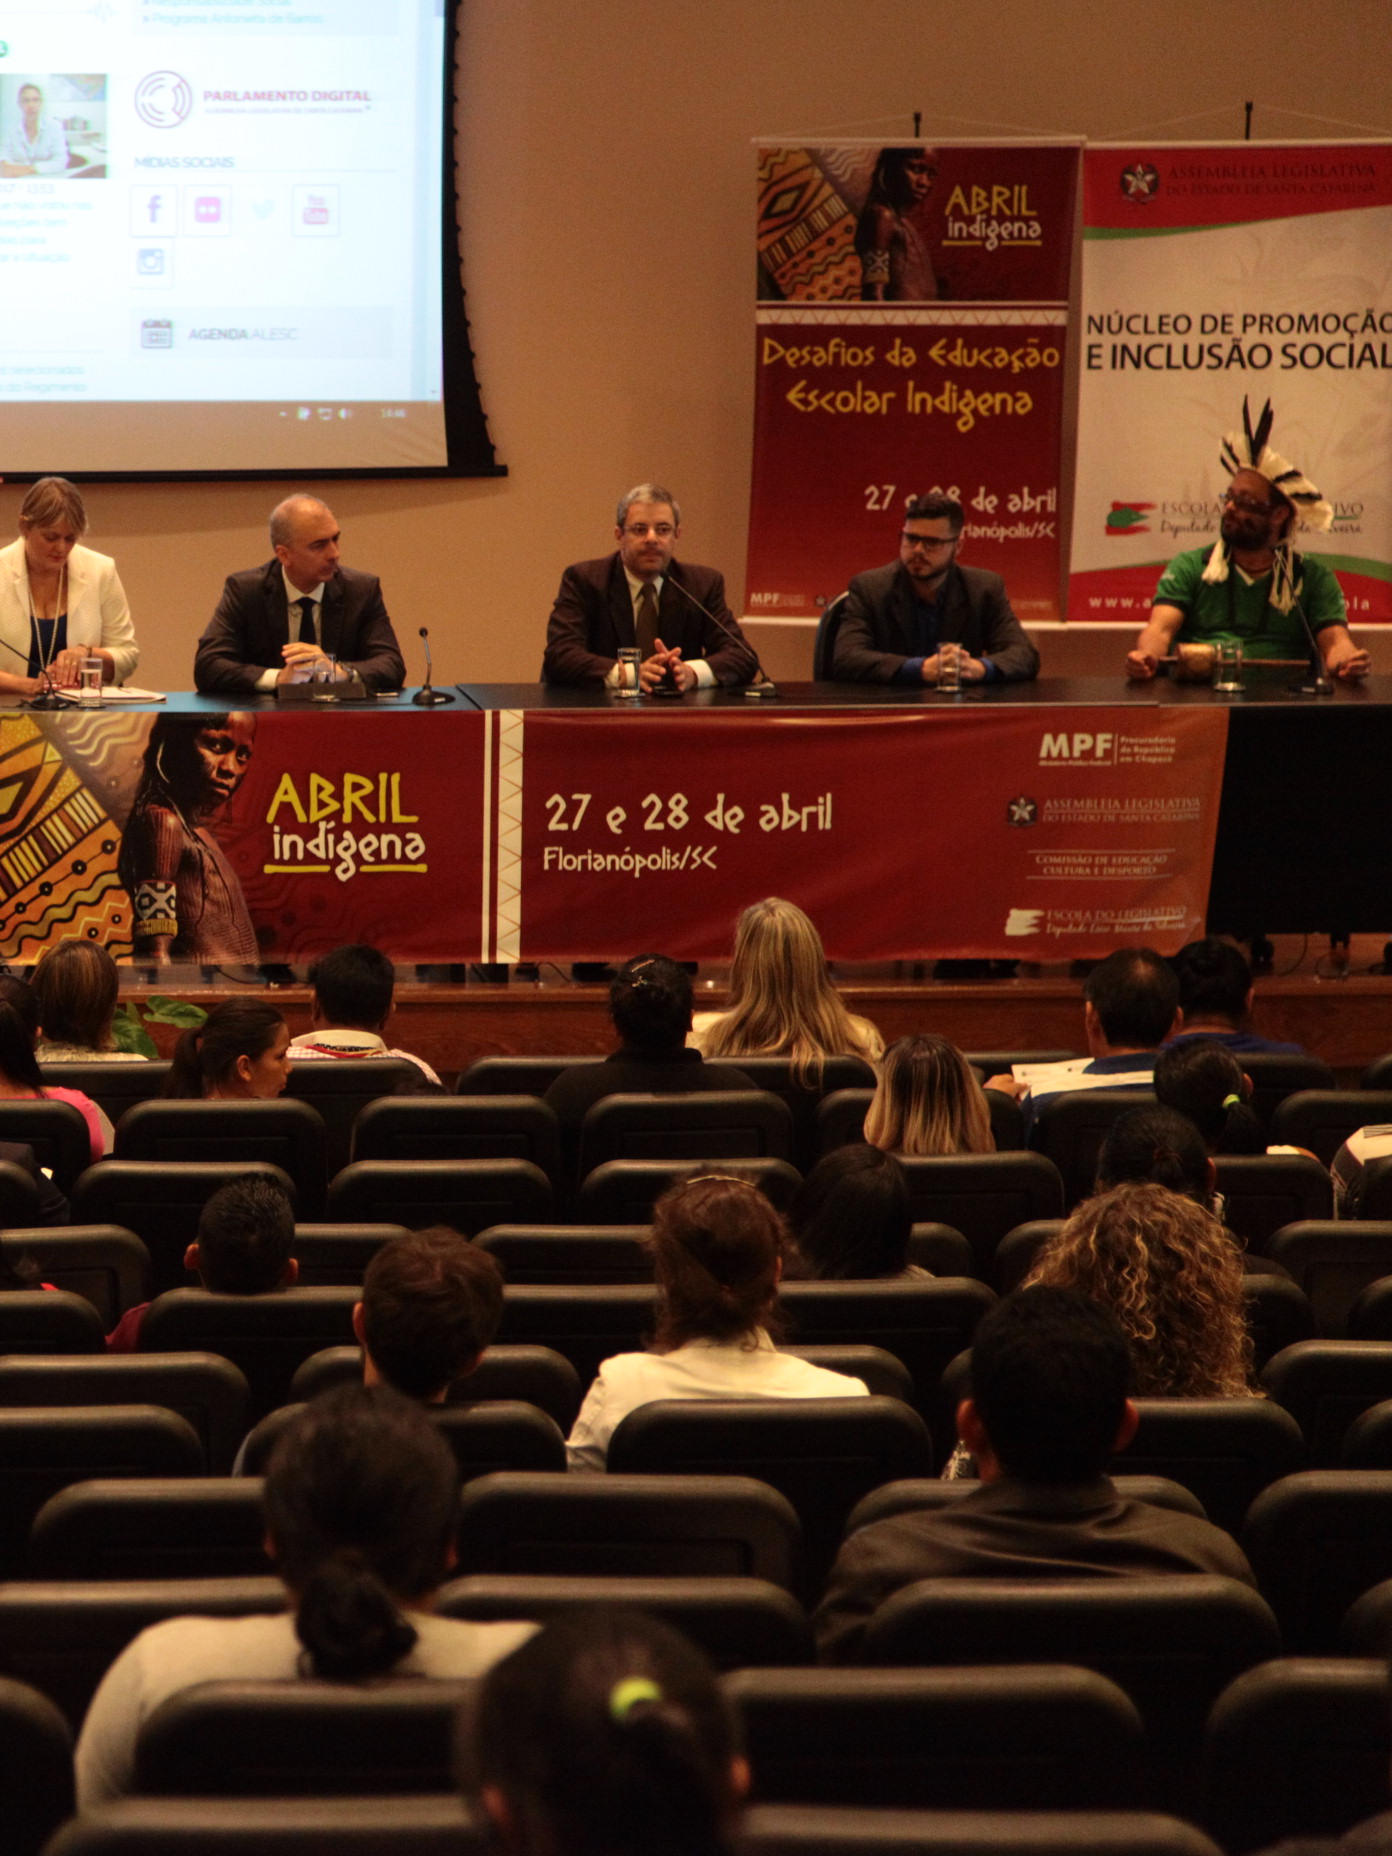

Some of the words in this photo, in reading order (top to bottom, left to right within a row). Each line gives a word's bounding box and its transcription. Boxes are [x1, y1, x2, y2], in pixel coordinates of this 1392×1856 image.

[203, 90, 308, 101] PARLAMENTO
[311, 90, 371, 101] DIGITAL
[945, 185, 1038, 216] ABRIL
[188, 328, 248, 341] AGENDA
[1087, 310, 1193, 335] NÚCLEO
[1200, 313, 1234, 335] DE
[1242, 308, 1392, 338] PROMOÇÃO
[763, 338, 875, 368] Desafios
[885, 338, 917, 367] da
[928, 338, 1060, 373] Educação
[1087, 343, 1103, 370] E
[1111, 336, 1273, 370] INCLUSÃO
[1280, 342, 1392, 370] SOCIAL
[786, 380, 896, 414] Escolar
[864, 484, 896, 512] 27
[970, 485, 999, 514] de
[1006, 486, 1057, 514] abril
[1038, 732, 1113, 759] MPF
[266, 772, 419, 824] ABRIL
[545, 793, 592, 832] 27
[606, 805, 627, 835] e
[641, 793, 690, 832] 28
[704, 792, 745, 835] de
[758, 792, 833, 833] abril
[273, 820, 426, 882] indígena
[543, 845, 718, 878] Florianópolis/SC
